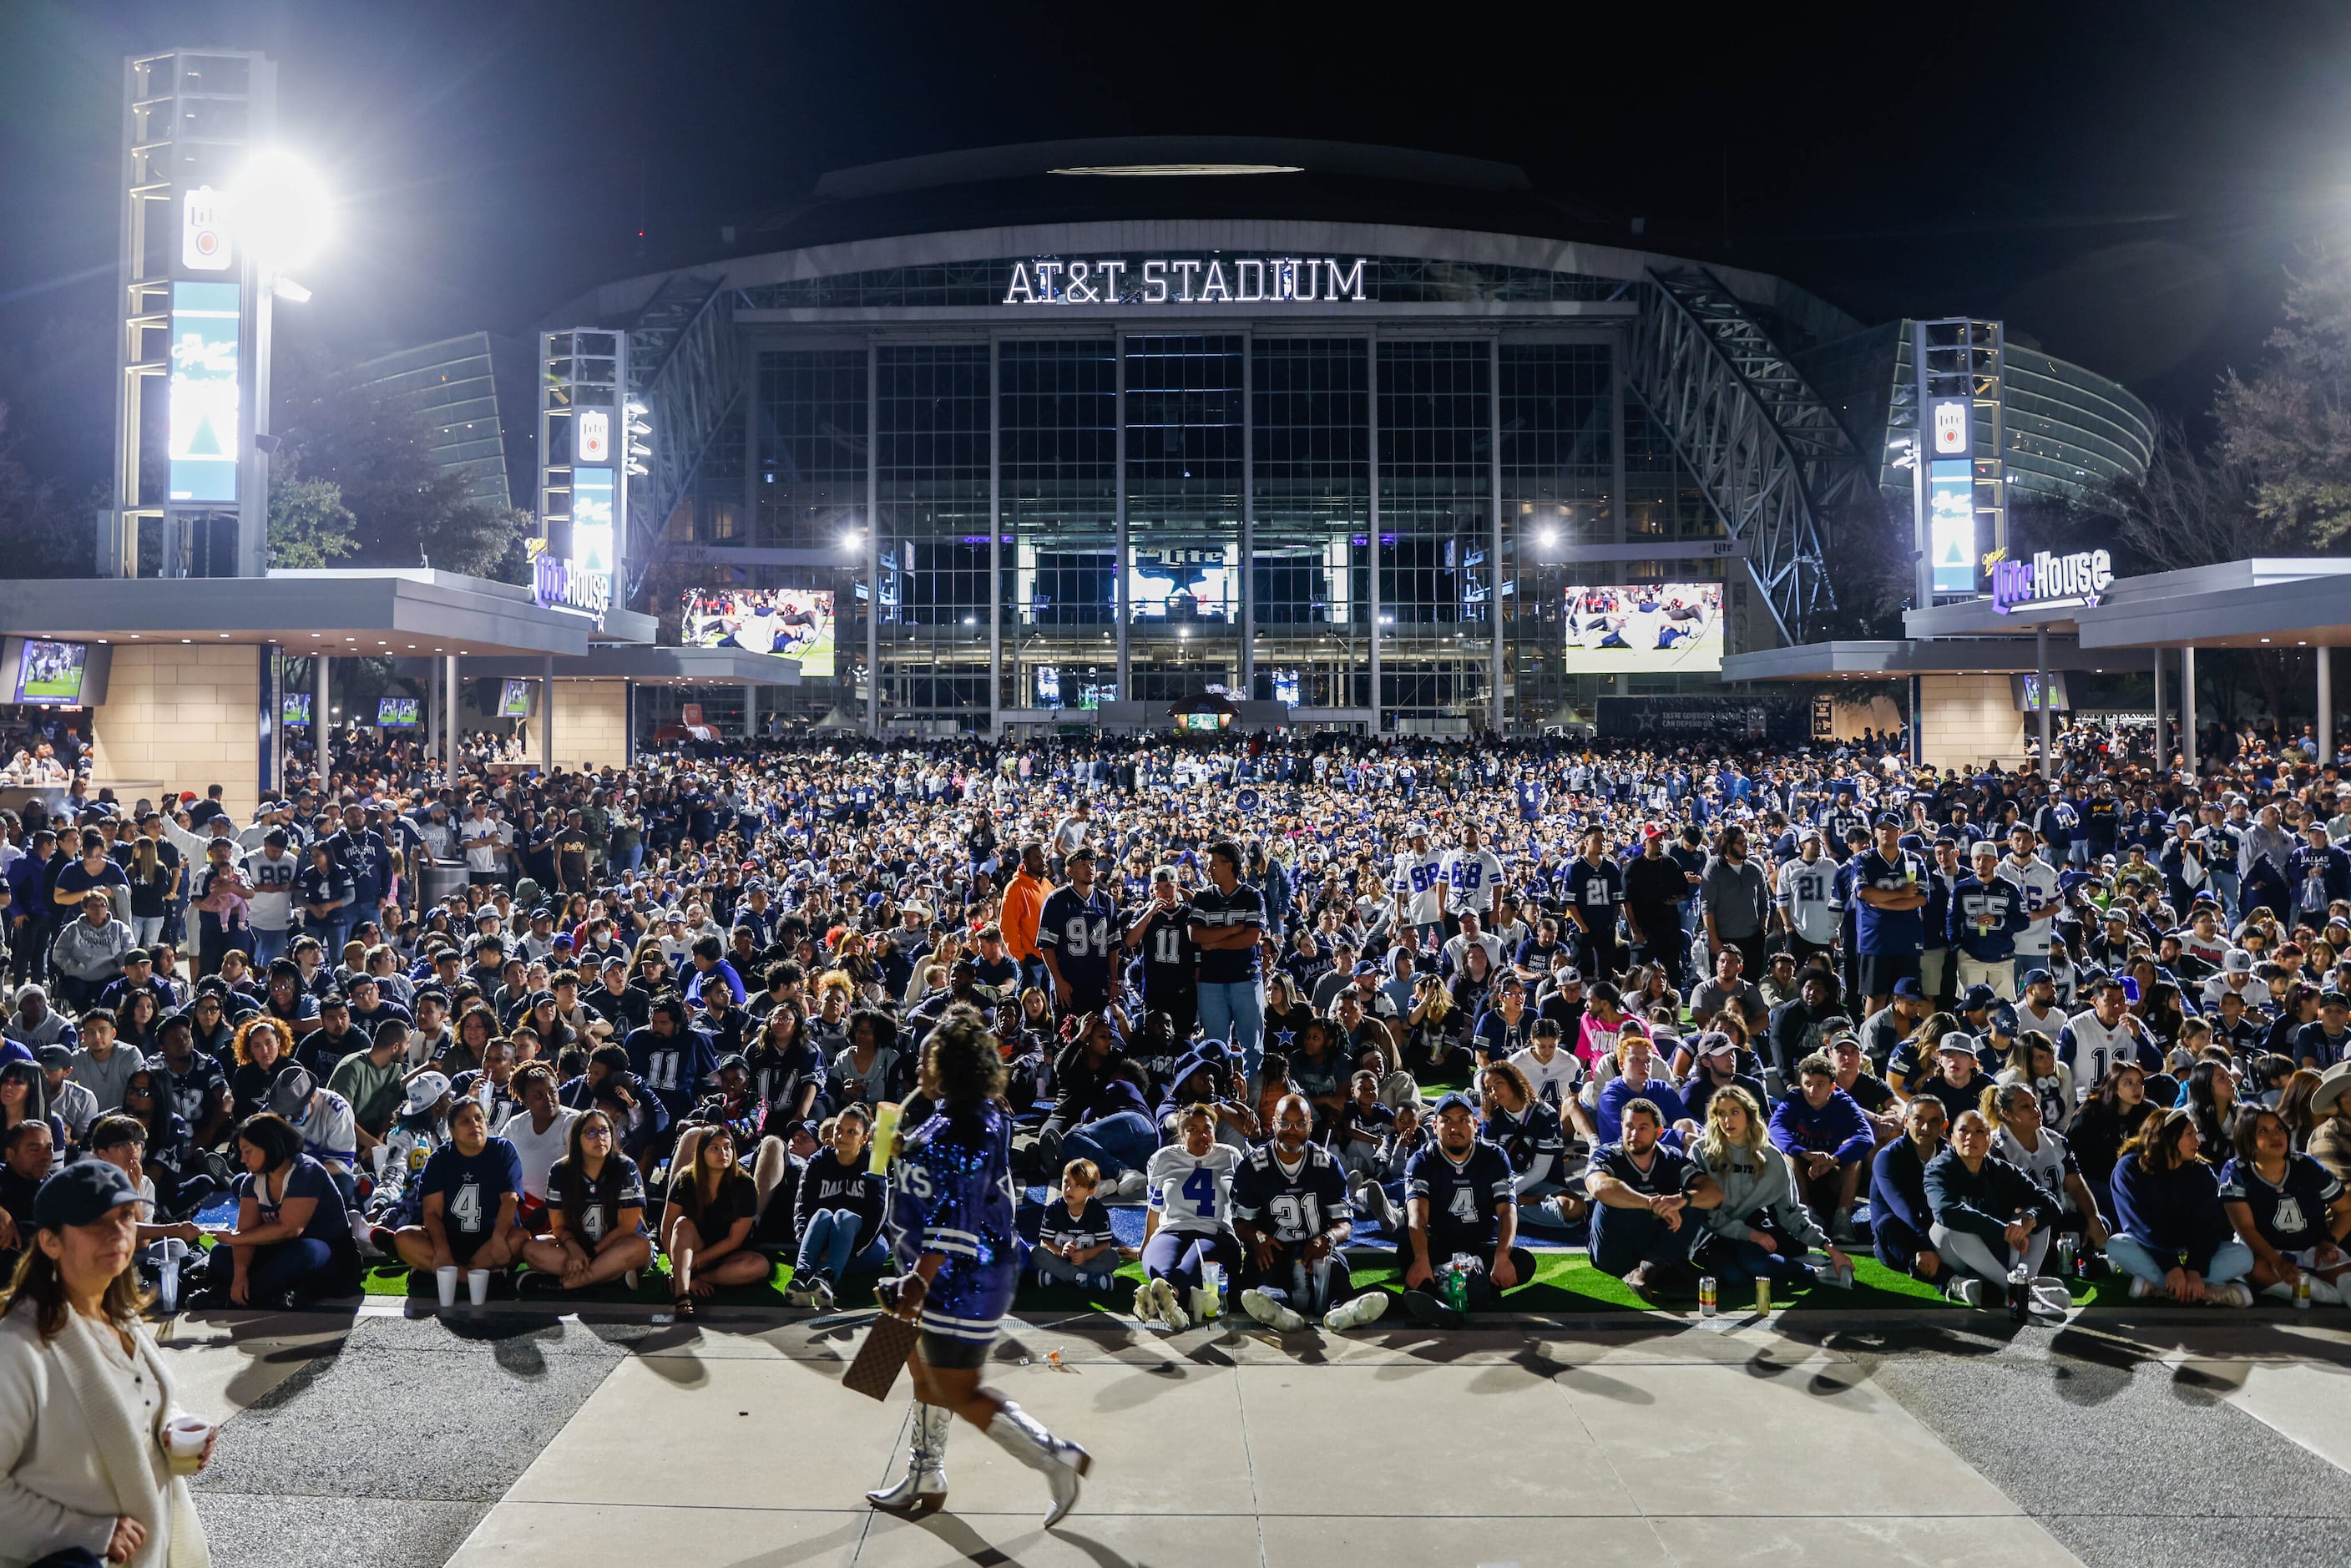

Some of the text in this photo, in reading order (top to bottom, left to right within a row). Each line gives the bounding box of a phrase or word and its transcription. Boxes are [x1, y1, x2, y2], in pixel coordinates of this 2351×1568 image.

[1002, 257, 1368, 306] AT&T STADIUM
[1158, 549, 1223, 566] Lite
[973, 833, 983, 847] 4
[1957, 835, 1969, 856] 4
[259, 866, 292, 885] 88
[318, 882, 331, 899] 4
[1586, 878, 1610, 906] 21
[1798, 875, 1826, 902] 21
[1065, 916, 1108, 958] 94
[1155, 928, 1181, 964] 11
[649, 1051, 680, 1090] 11
[451, 1182, 482, 1232] 4
[818, 1179, 866, 1201] DALLAS
[1182, 1168, 1216, 1216] 4
[1448, 1187, 1479, 1222] 4
[582, 1204, 603, 1243] 4
[1270, 1192, 1320, 1242] 21
[2272, 1196, 2307, 1233] 4
